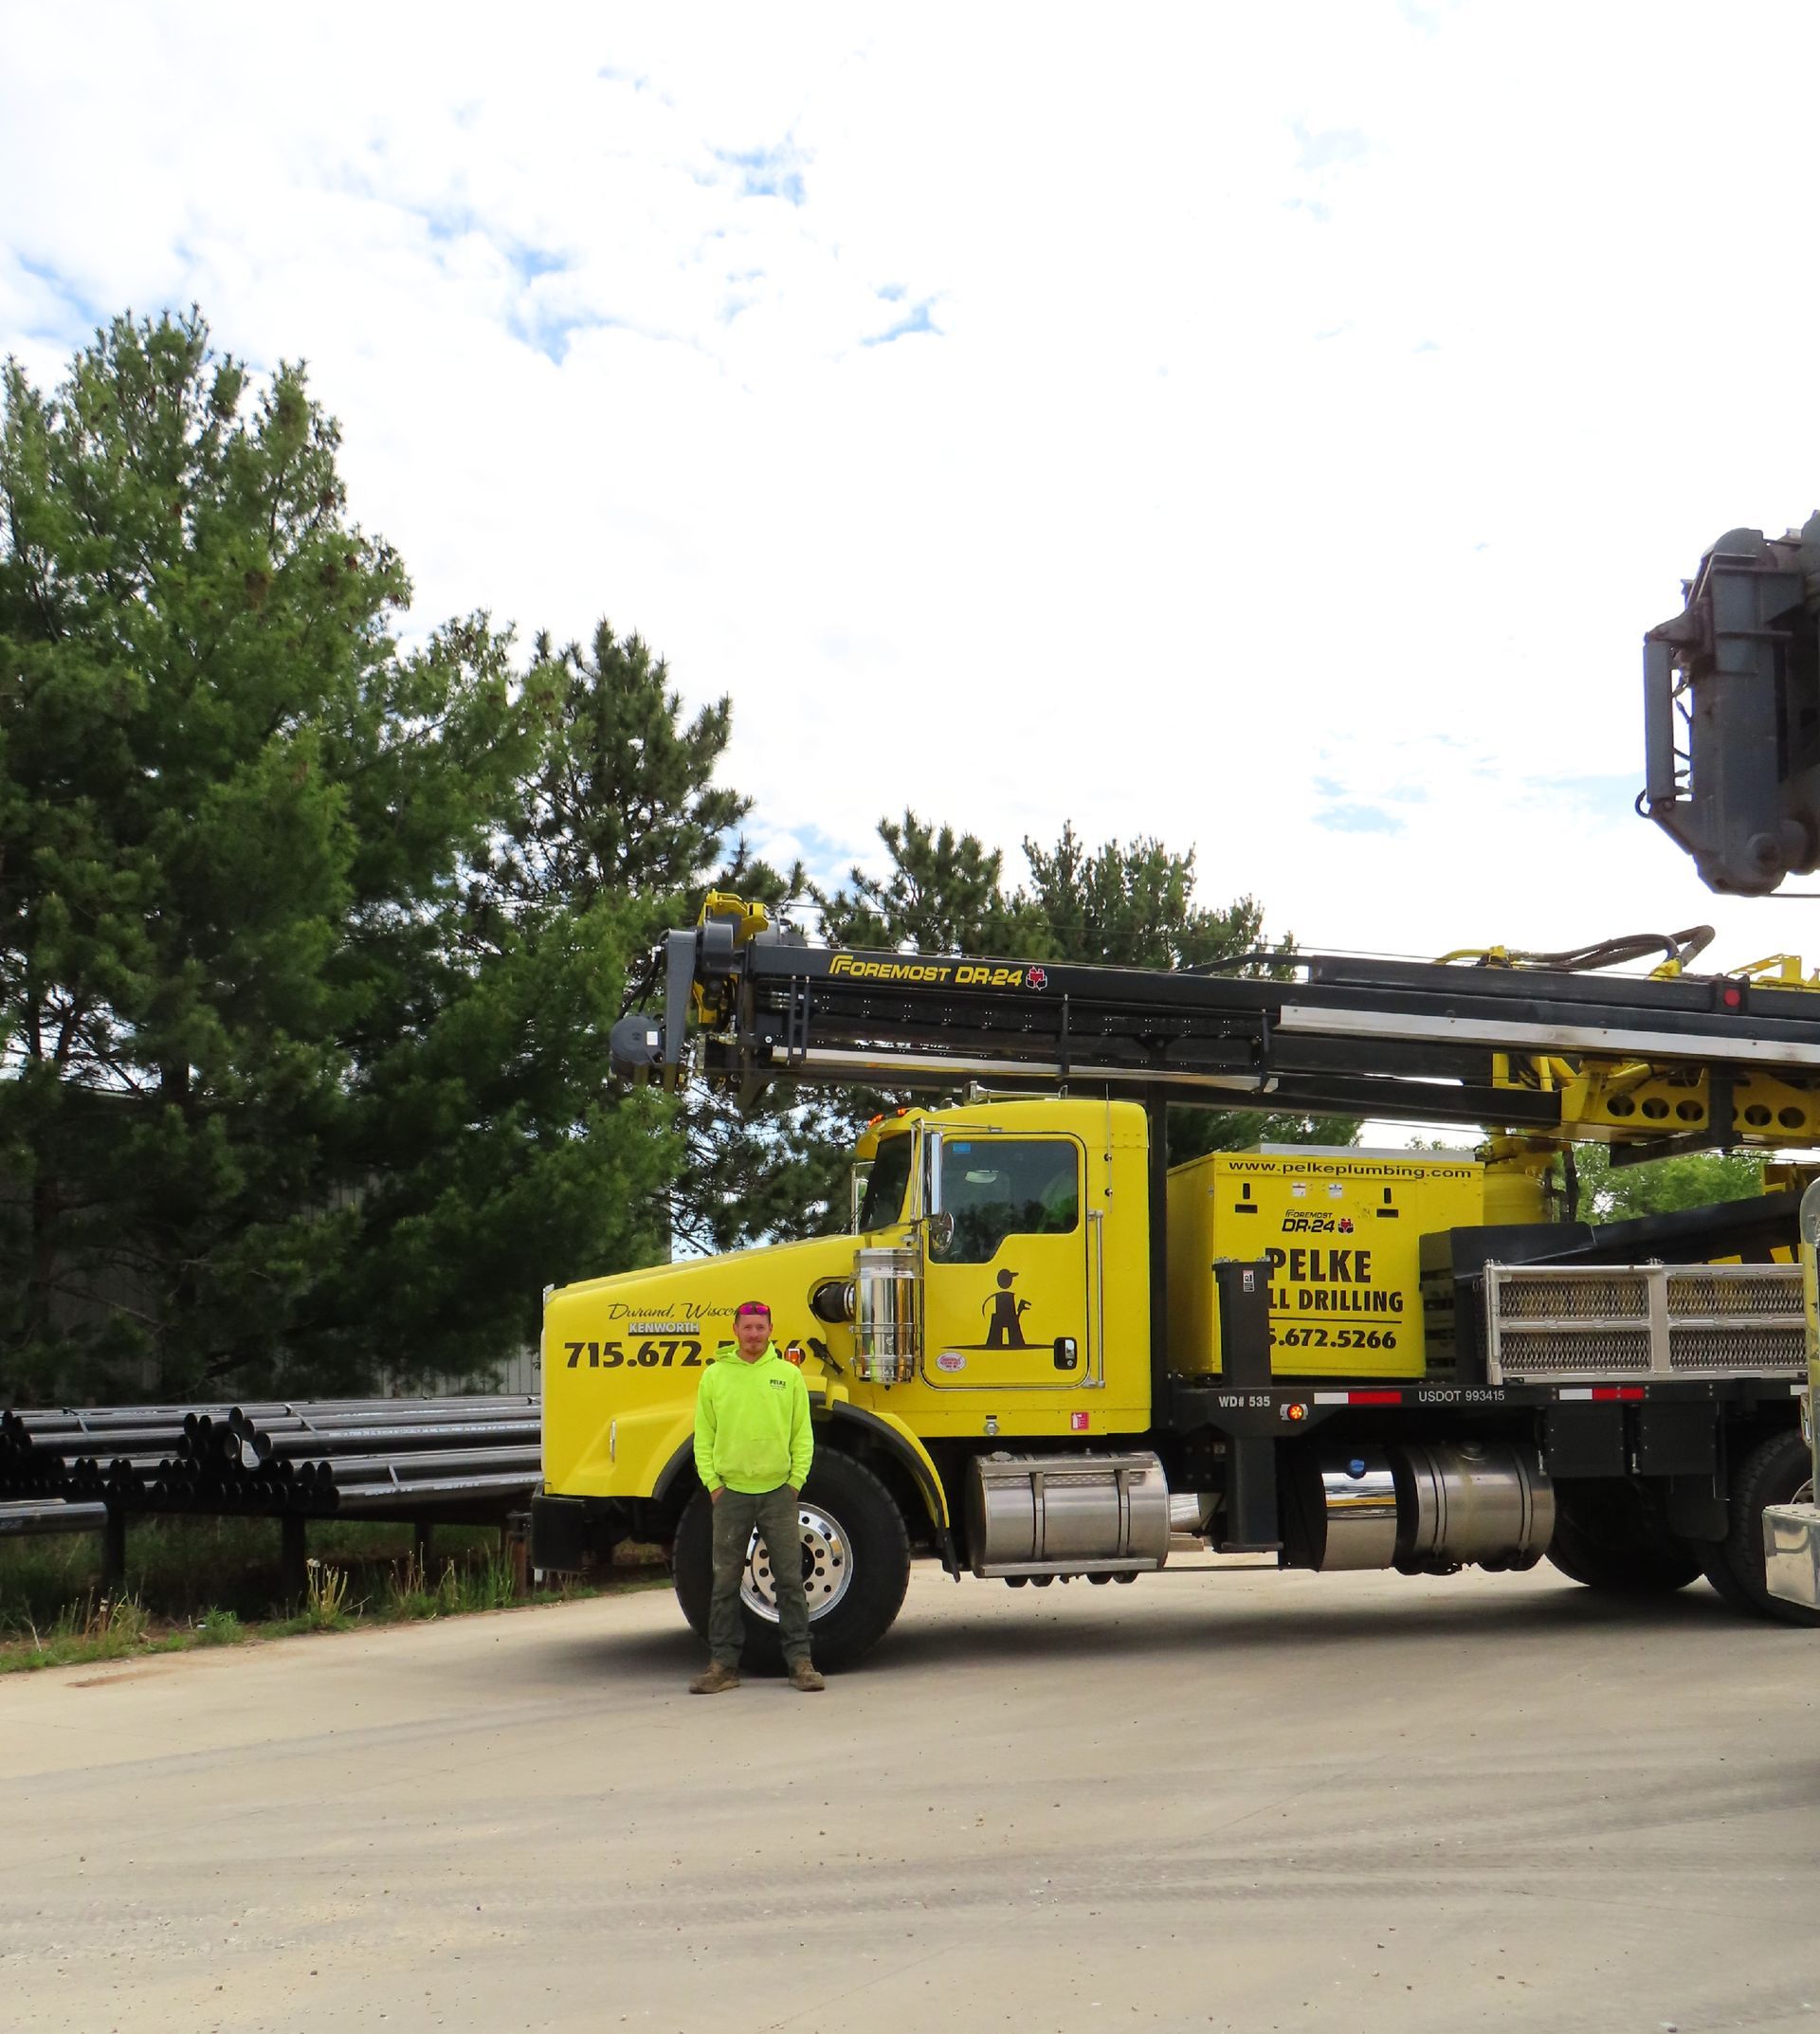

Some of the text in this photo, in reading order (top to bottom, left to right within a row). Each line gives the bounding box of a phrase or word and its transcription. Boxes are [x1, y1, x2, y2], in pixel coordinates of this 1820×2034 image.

[828, 954, 1023, 987] FOREMOST DR-24
[1228, 1161, 1471, 1179] www.pelkeplumbing.com
[1285, 1208, 1334, 1219] FOREMOST
[1265, 1247, 1371, 1283] PELKE
[1268, 1288, 1404, 1313] LL DRILLING
[608, 1302, 676, 1319] Durand,
[628, 1321, 700, 1334] KENWORTH
[1268, 1328, 1396, 1350] 5.672.5266
[564, 1338, 806, 1368] 715.672.6
[1218, 1395, 1271, 1407] WD# 535
[1418, 1389, 1505, 1403] USDOT 993415
